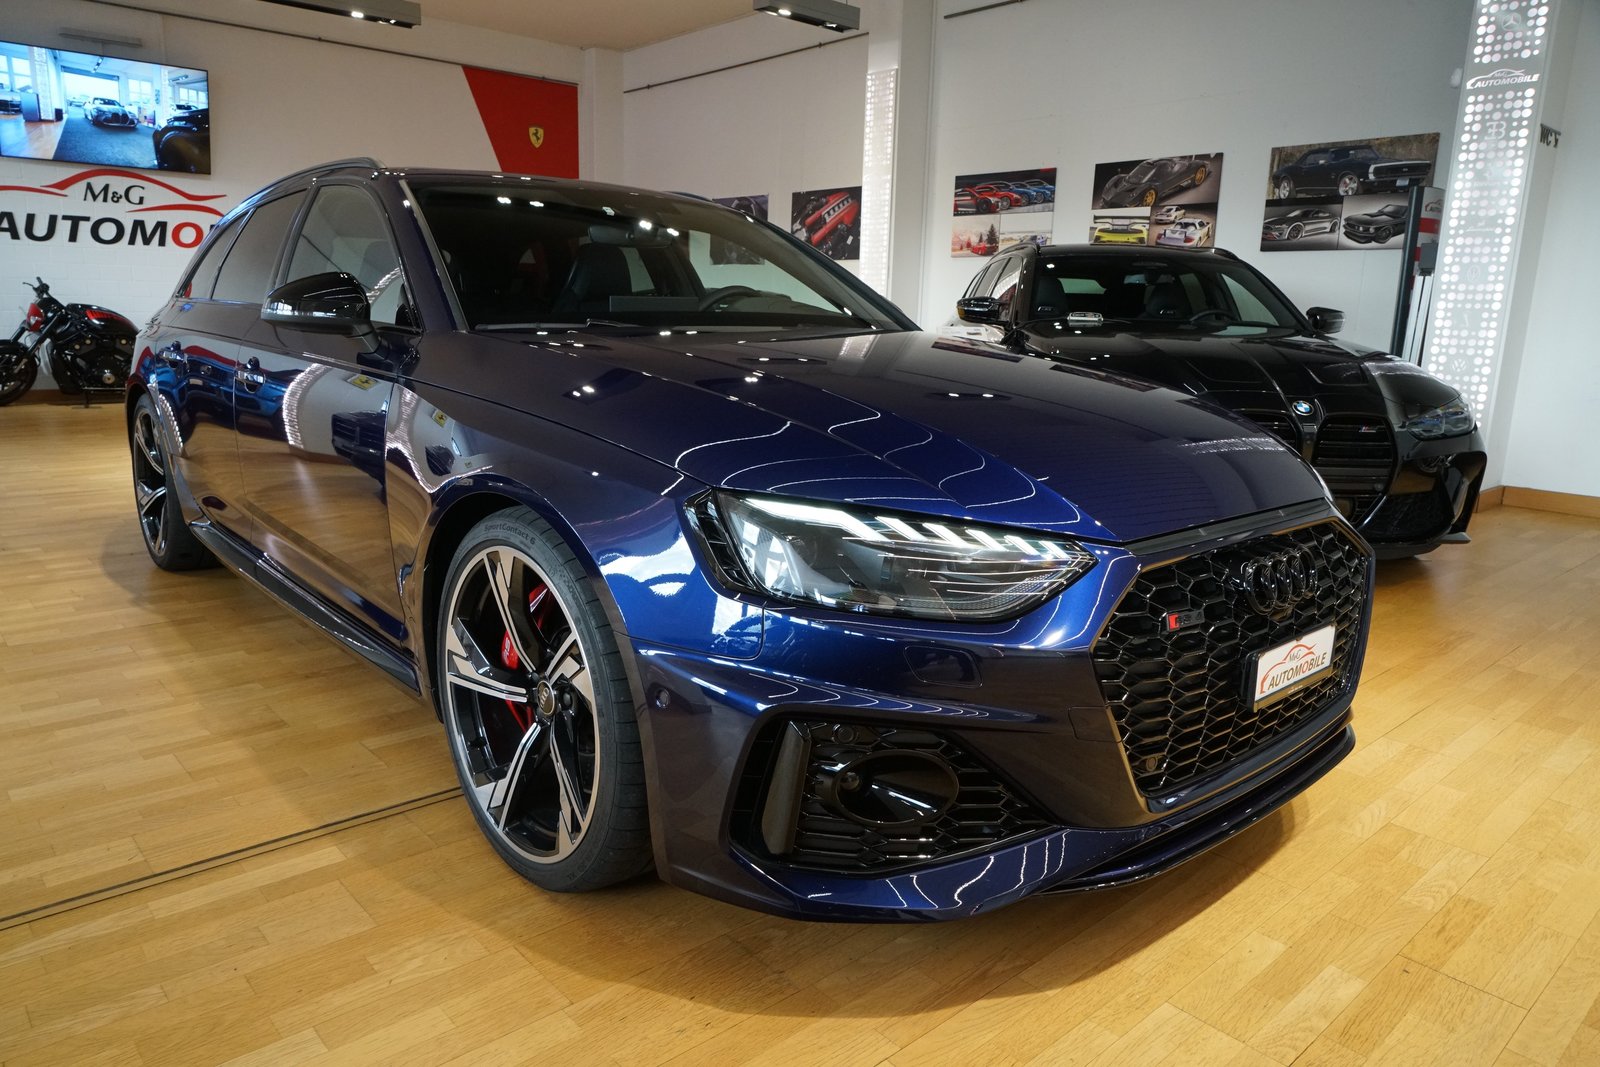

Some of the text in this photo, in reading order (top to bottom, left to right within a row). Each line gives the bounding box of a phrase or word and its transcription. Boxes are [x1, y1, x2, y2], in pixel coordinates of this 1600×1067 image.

[1474, 73, 1540, 88] AUTOMOBILE
[83, 181, 145, 205] M&G
[0, 210, 216, 248] AUTOMO
[1267, 652, 1327, 691] AUTOMOBILE
